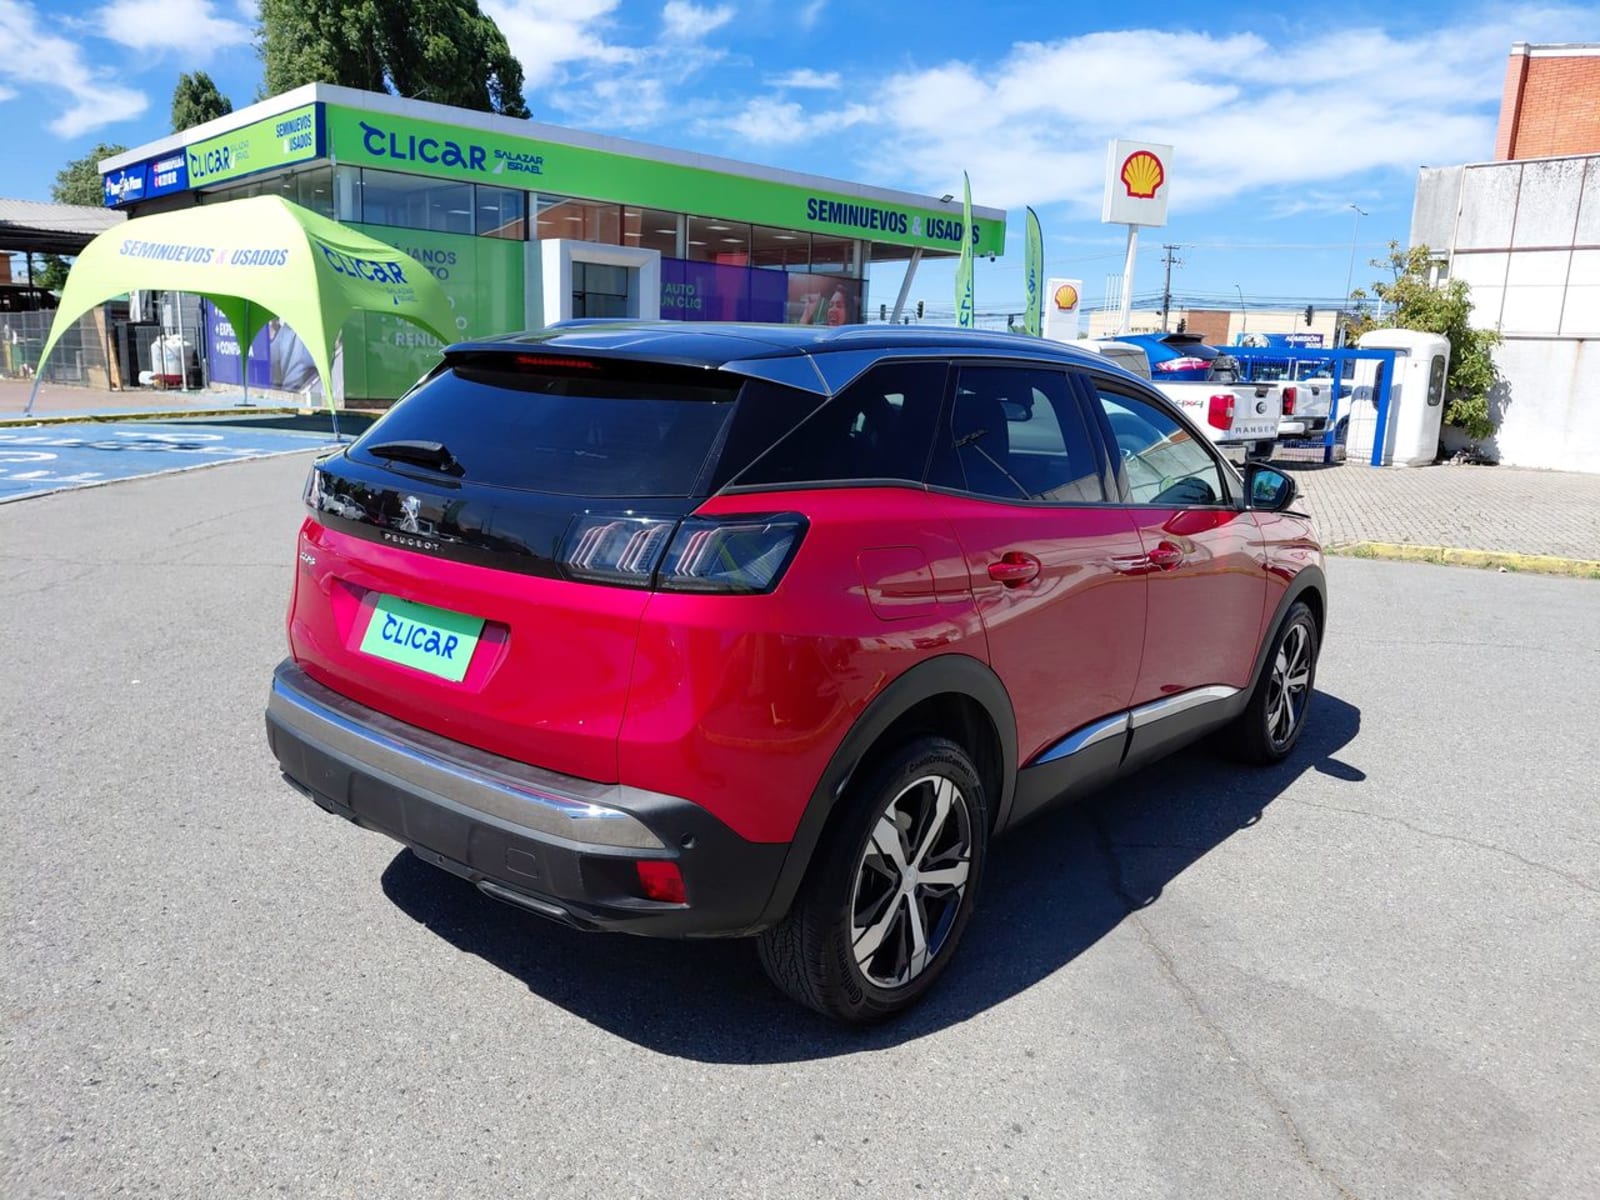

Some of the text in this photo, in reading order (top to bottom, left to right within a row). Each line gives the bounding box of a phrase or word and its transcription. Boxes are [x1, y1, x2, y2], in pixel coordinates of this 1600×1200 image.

[276, 114, 311, 137] SEMINUEVOS
[289, 132, 312, 152] USADOS
[494, 149, 543, 166] SALAZAR
[507, 162, 543, 175] ISRAEL
[807, 198, 980, 245] SEMINUEVOS & USADS
[119, 239, 215, 264] SEMINUEVOS
[230, 249, 289, 266] USADOS
[665, 283, 695, 296] AUTO
[384, 533, 441, 551] PEUGEOT
